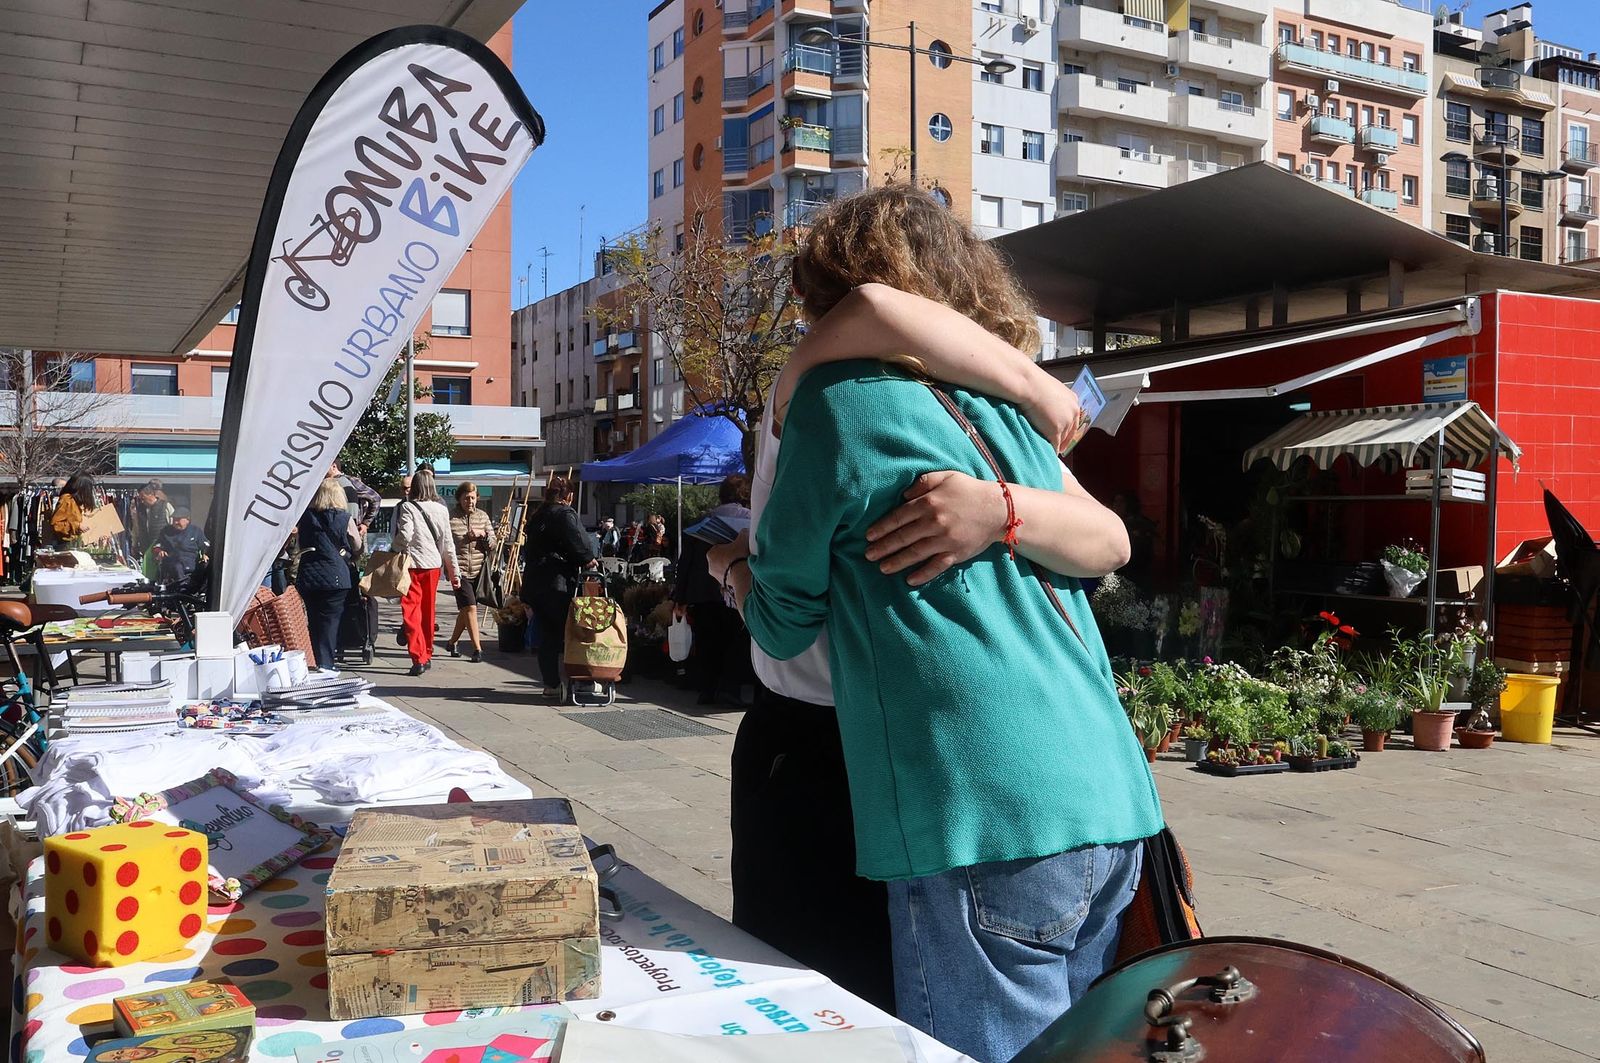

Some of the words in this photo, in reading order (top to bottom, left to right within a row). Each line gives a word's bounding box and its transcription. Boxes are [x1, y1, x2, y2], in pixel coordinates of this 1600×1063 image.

[325, 63, 472, 243] ONUBA
[243, 380, 354, 527] TURISMO
[334, 241, 440, 379] URBANO
[619, 945, 681, 992] Proyectos
[720, 1022, 748, 1036] ón
[745, 997, 811, 1033] ursos
